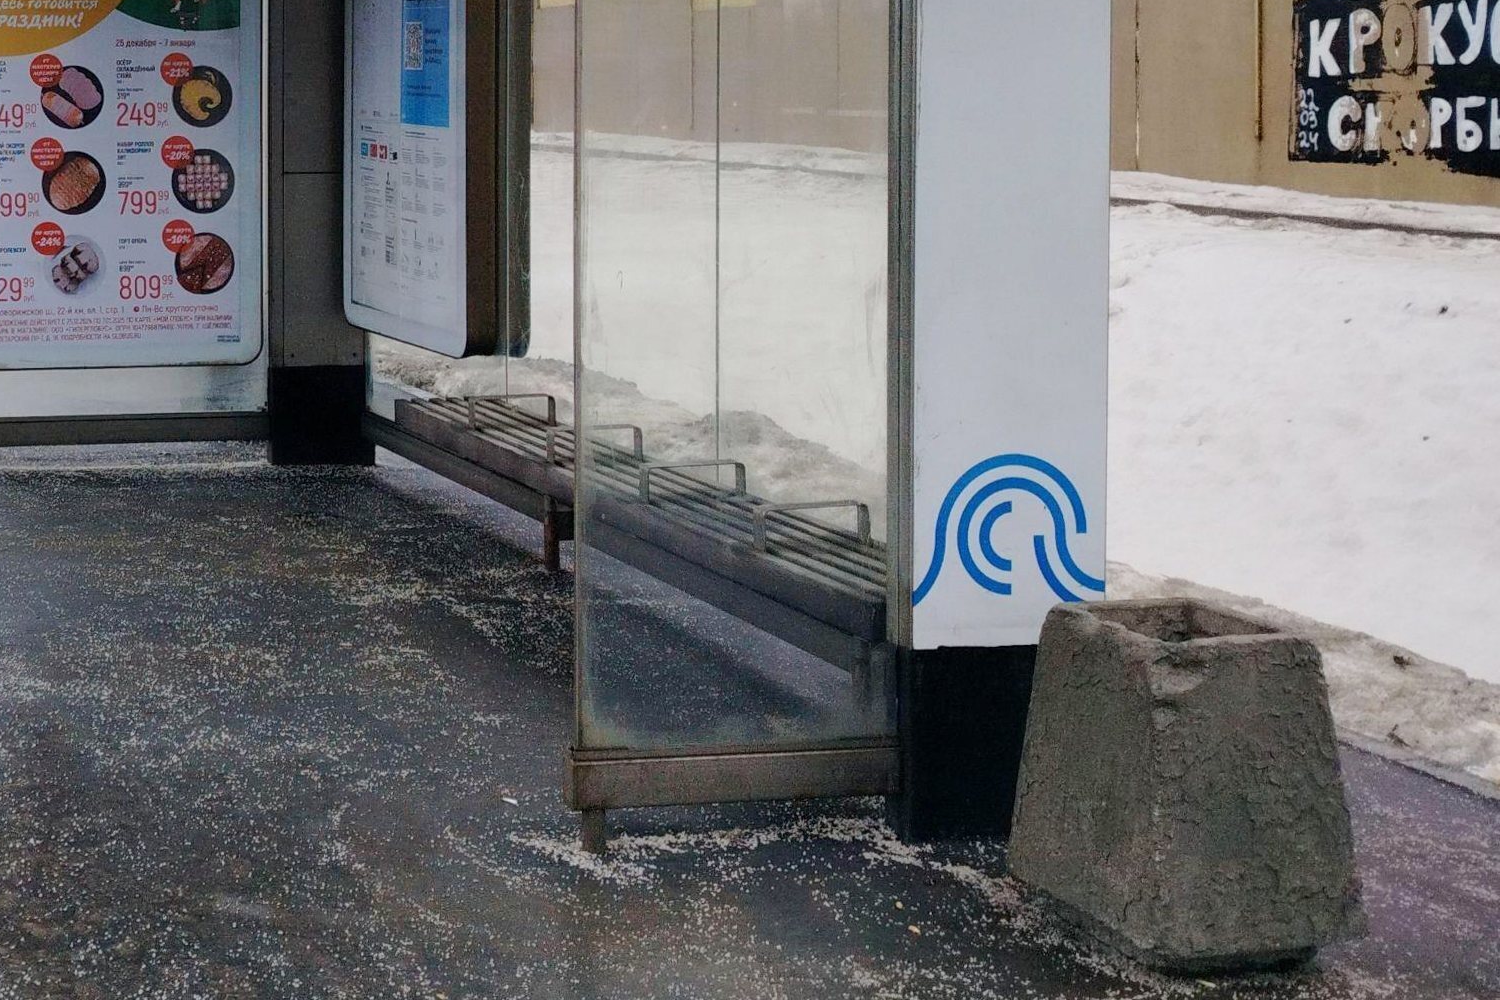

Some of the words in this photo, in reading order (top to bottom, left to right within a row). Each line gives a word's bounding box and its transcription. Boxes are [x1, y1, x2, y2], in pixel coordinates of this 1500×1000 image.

[116, 102, 156, 127] 249
[117, 190, 157, 215] 799
[119, 275, 160, 300] 809
